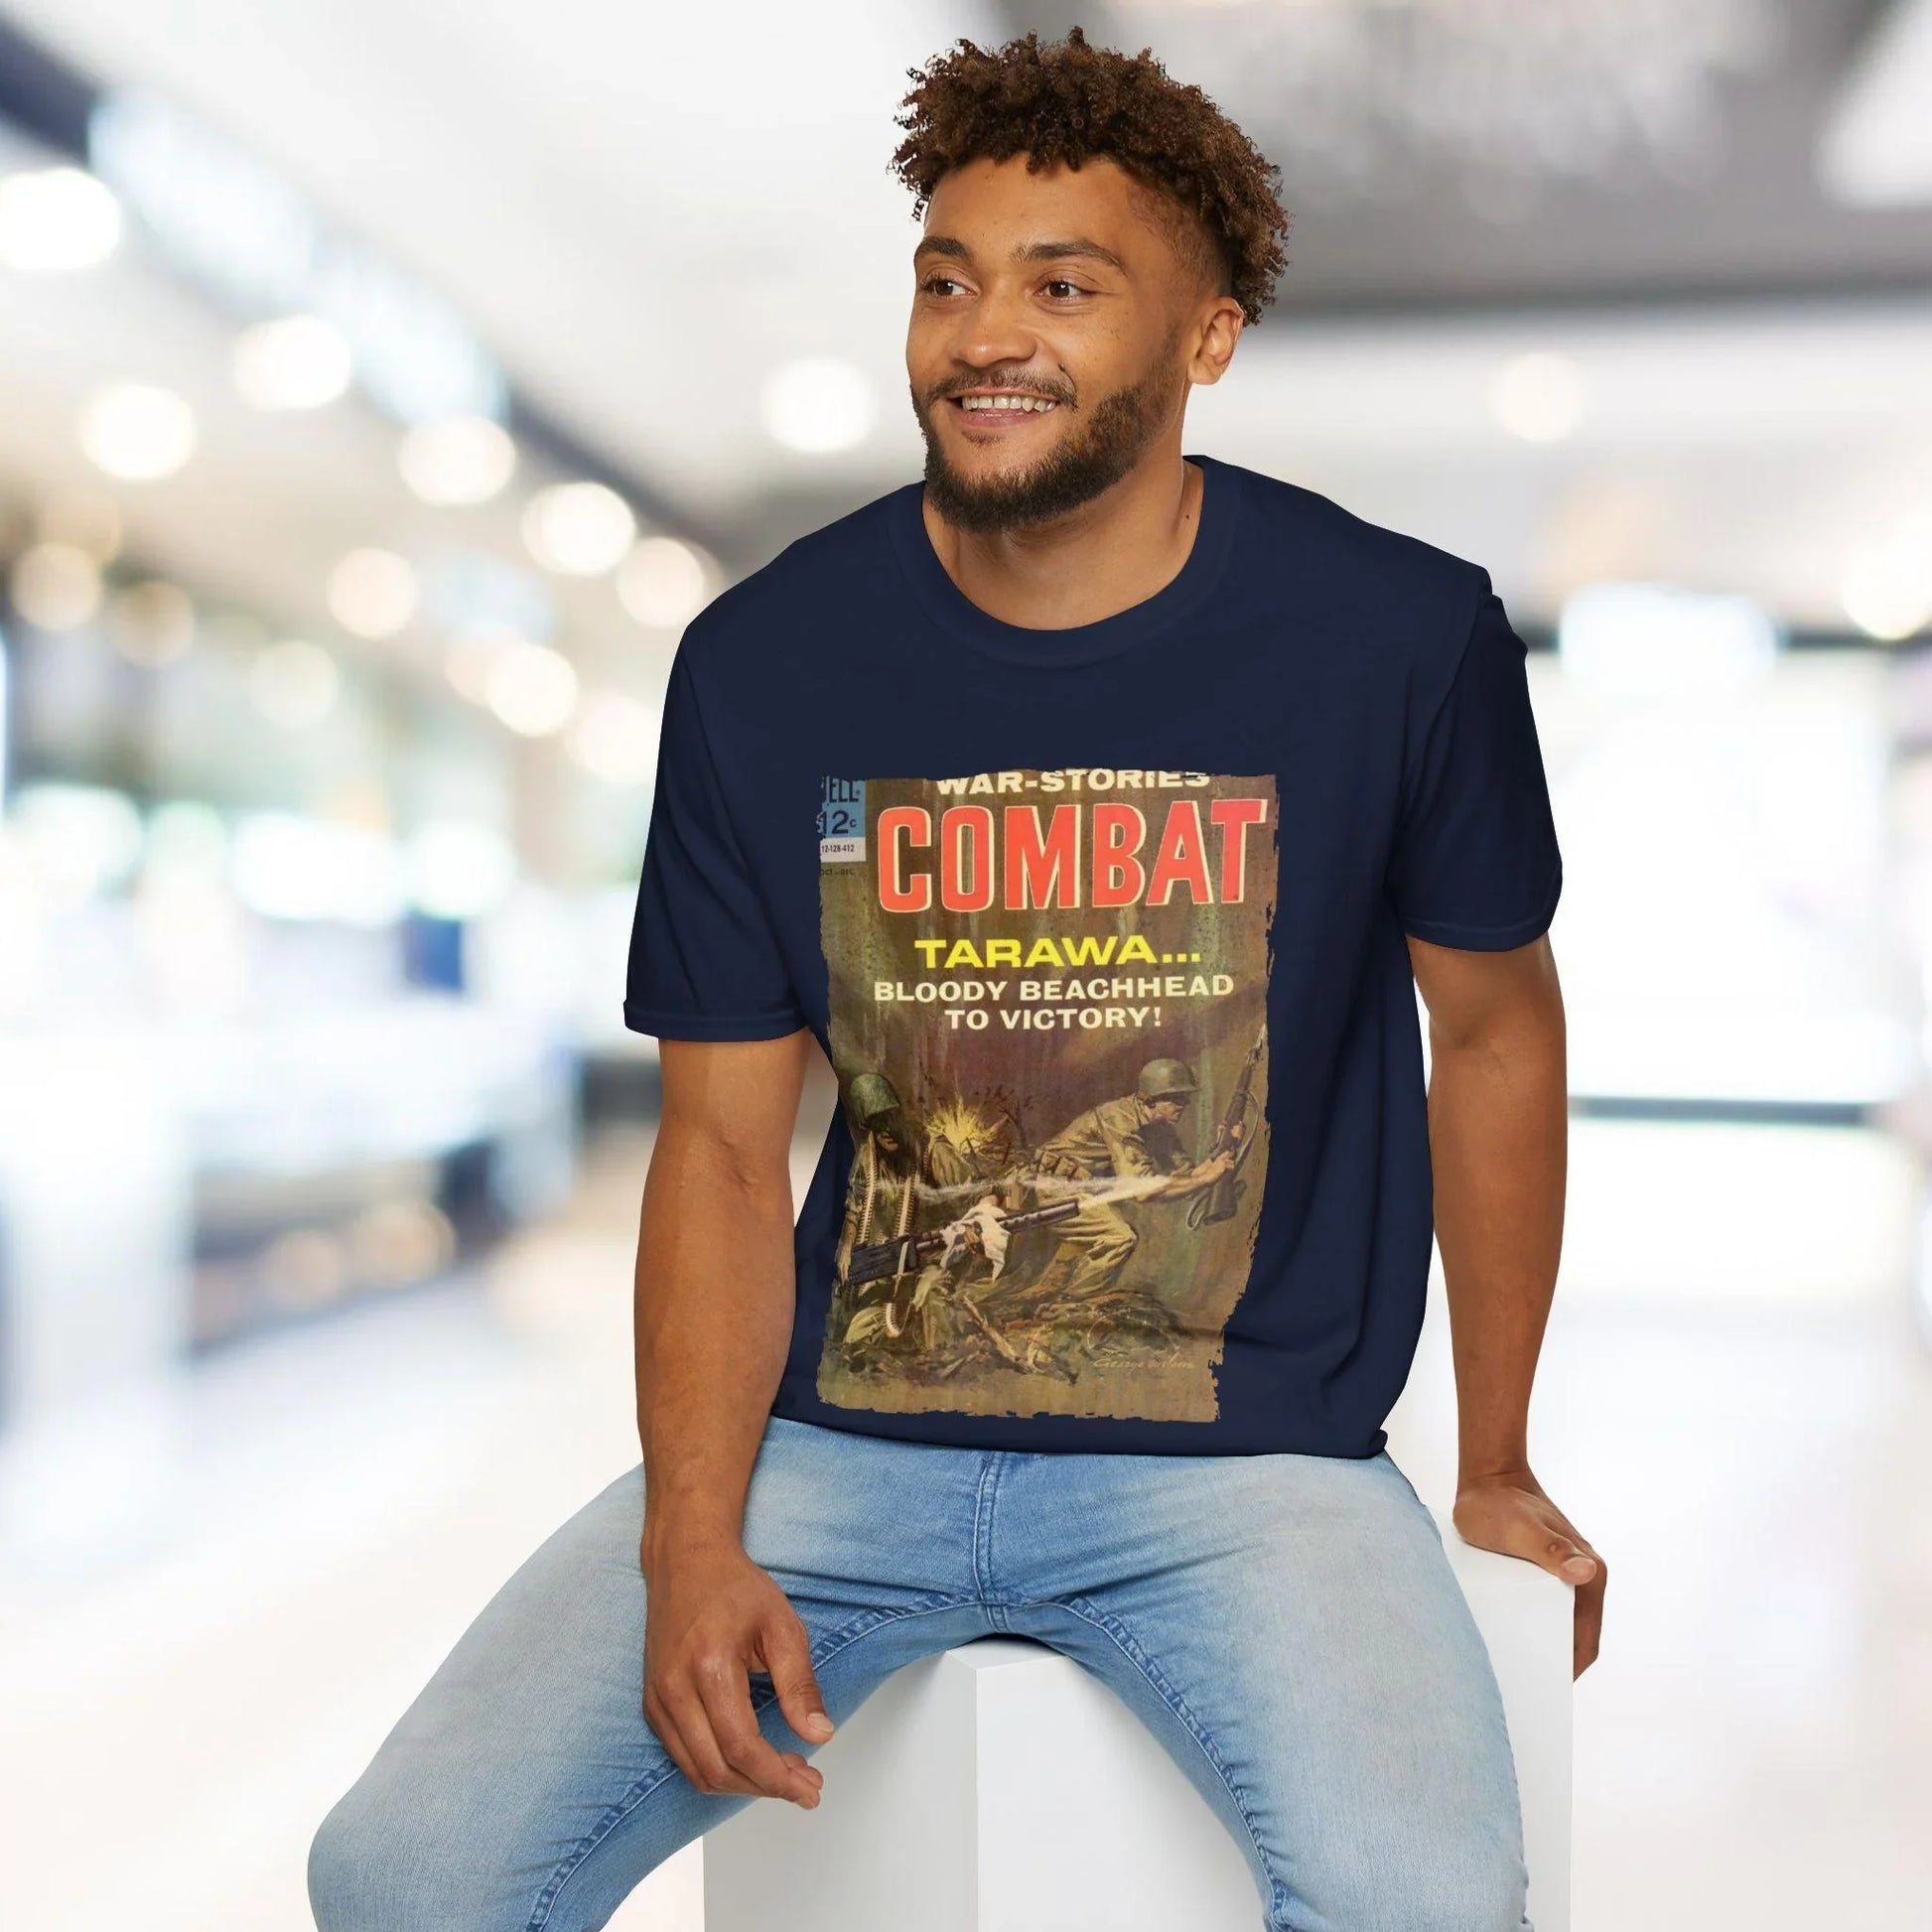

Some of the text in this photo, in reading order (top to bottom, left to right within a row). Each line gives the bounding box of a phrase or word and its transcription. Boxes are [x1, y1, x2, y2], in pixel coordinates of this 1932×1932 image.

[936, 768, 1210, 795] WAR-STORIES
[878, 799, 1268, 912] COMBAT
[914, 934, 1201, 969] TARAWA...
[875, 975, 1234, 1003] BLOODY BEACHHEAD
[944, 1006, 1162, 1031] TO VICTORY!
